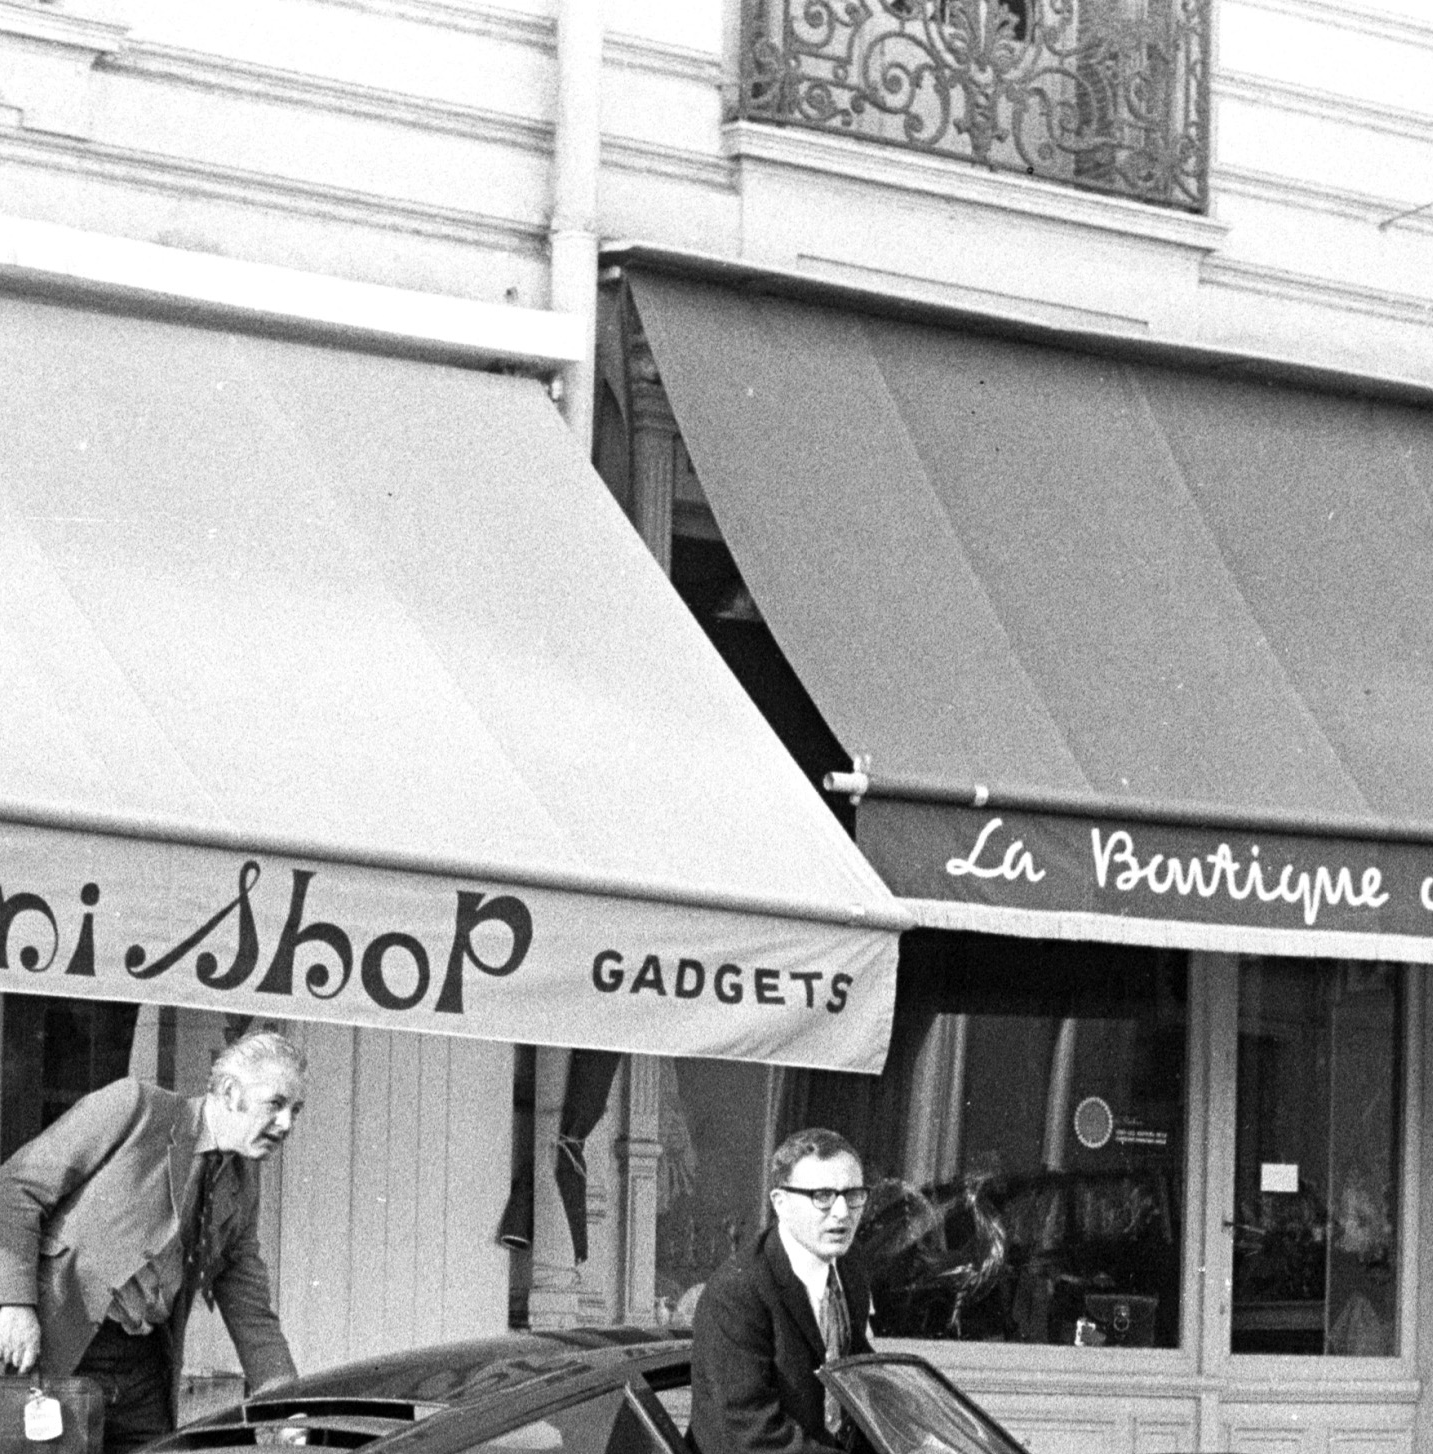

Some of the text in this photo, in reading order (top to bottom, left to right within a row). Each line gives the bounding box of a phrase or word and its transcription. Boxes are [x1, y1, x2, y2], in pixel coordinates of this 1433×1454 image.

[945, 817, 1046, 882] La
[1092, 827, 1390, 925] Boutique
[124, 860, 533, 1015] Shop
[592, 948, 855, 1014] GADGETS
